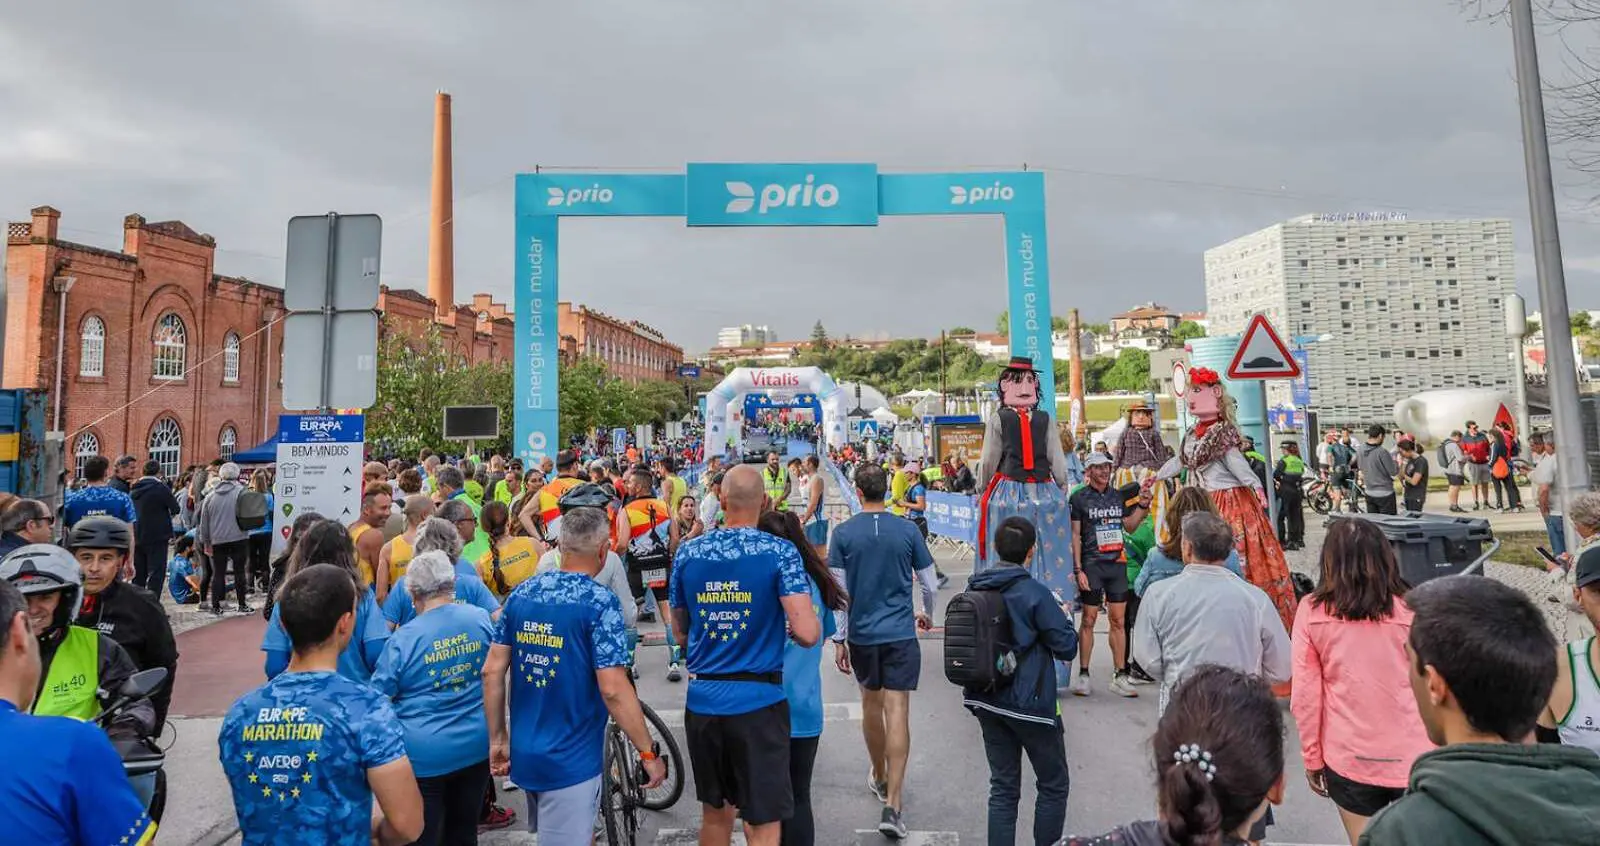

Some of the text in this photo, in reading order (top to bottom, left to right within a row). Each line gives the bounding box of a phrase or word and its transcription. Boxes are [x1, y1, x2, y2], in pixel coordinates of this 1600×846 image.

[567, 184, 613, 206] prio
[759, 174, 839, 214] prio
[969, 181, 1014, 204] prio
[1017, 232, 1035, 290] mudar
[527, 236, 545, 409] Energia para mudar
[1023, 292, 1039, 333] para
[750, 371, 799, 386] Vitalis
[291, 445, 350, 457] BEM-VINDOS
[696, 592, 752, 603] MARATHON
[516, 631, 564, 649] MARATHON
[423, 641, 481, 664] MARATHON
[242, 723, 324, 741] MARATHON
